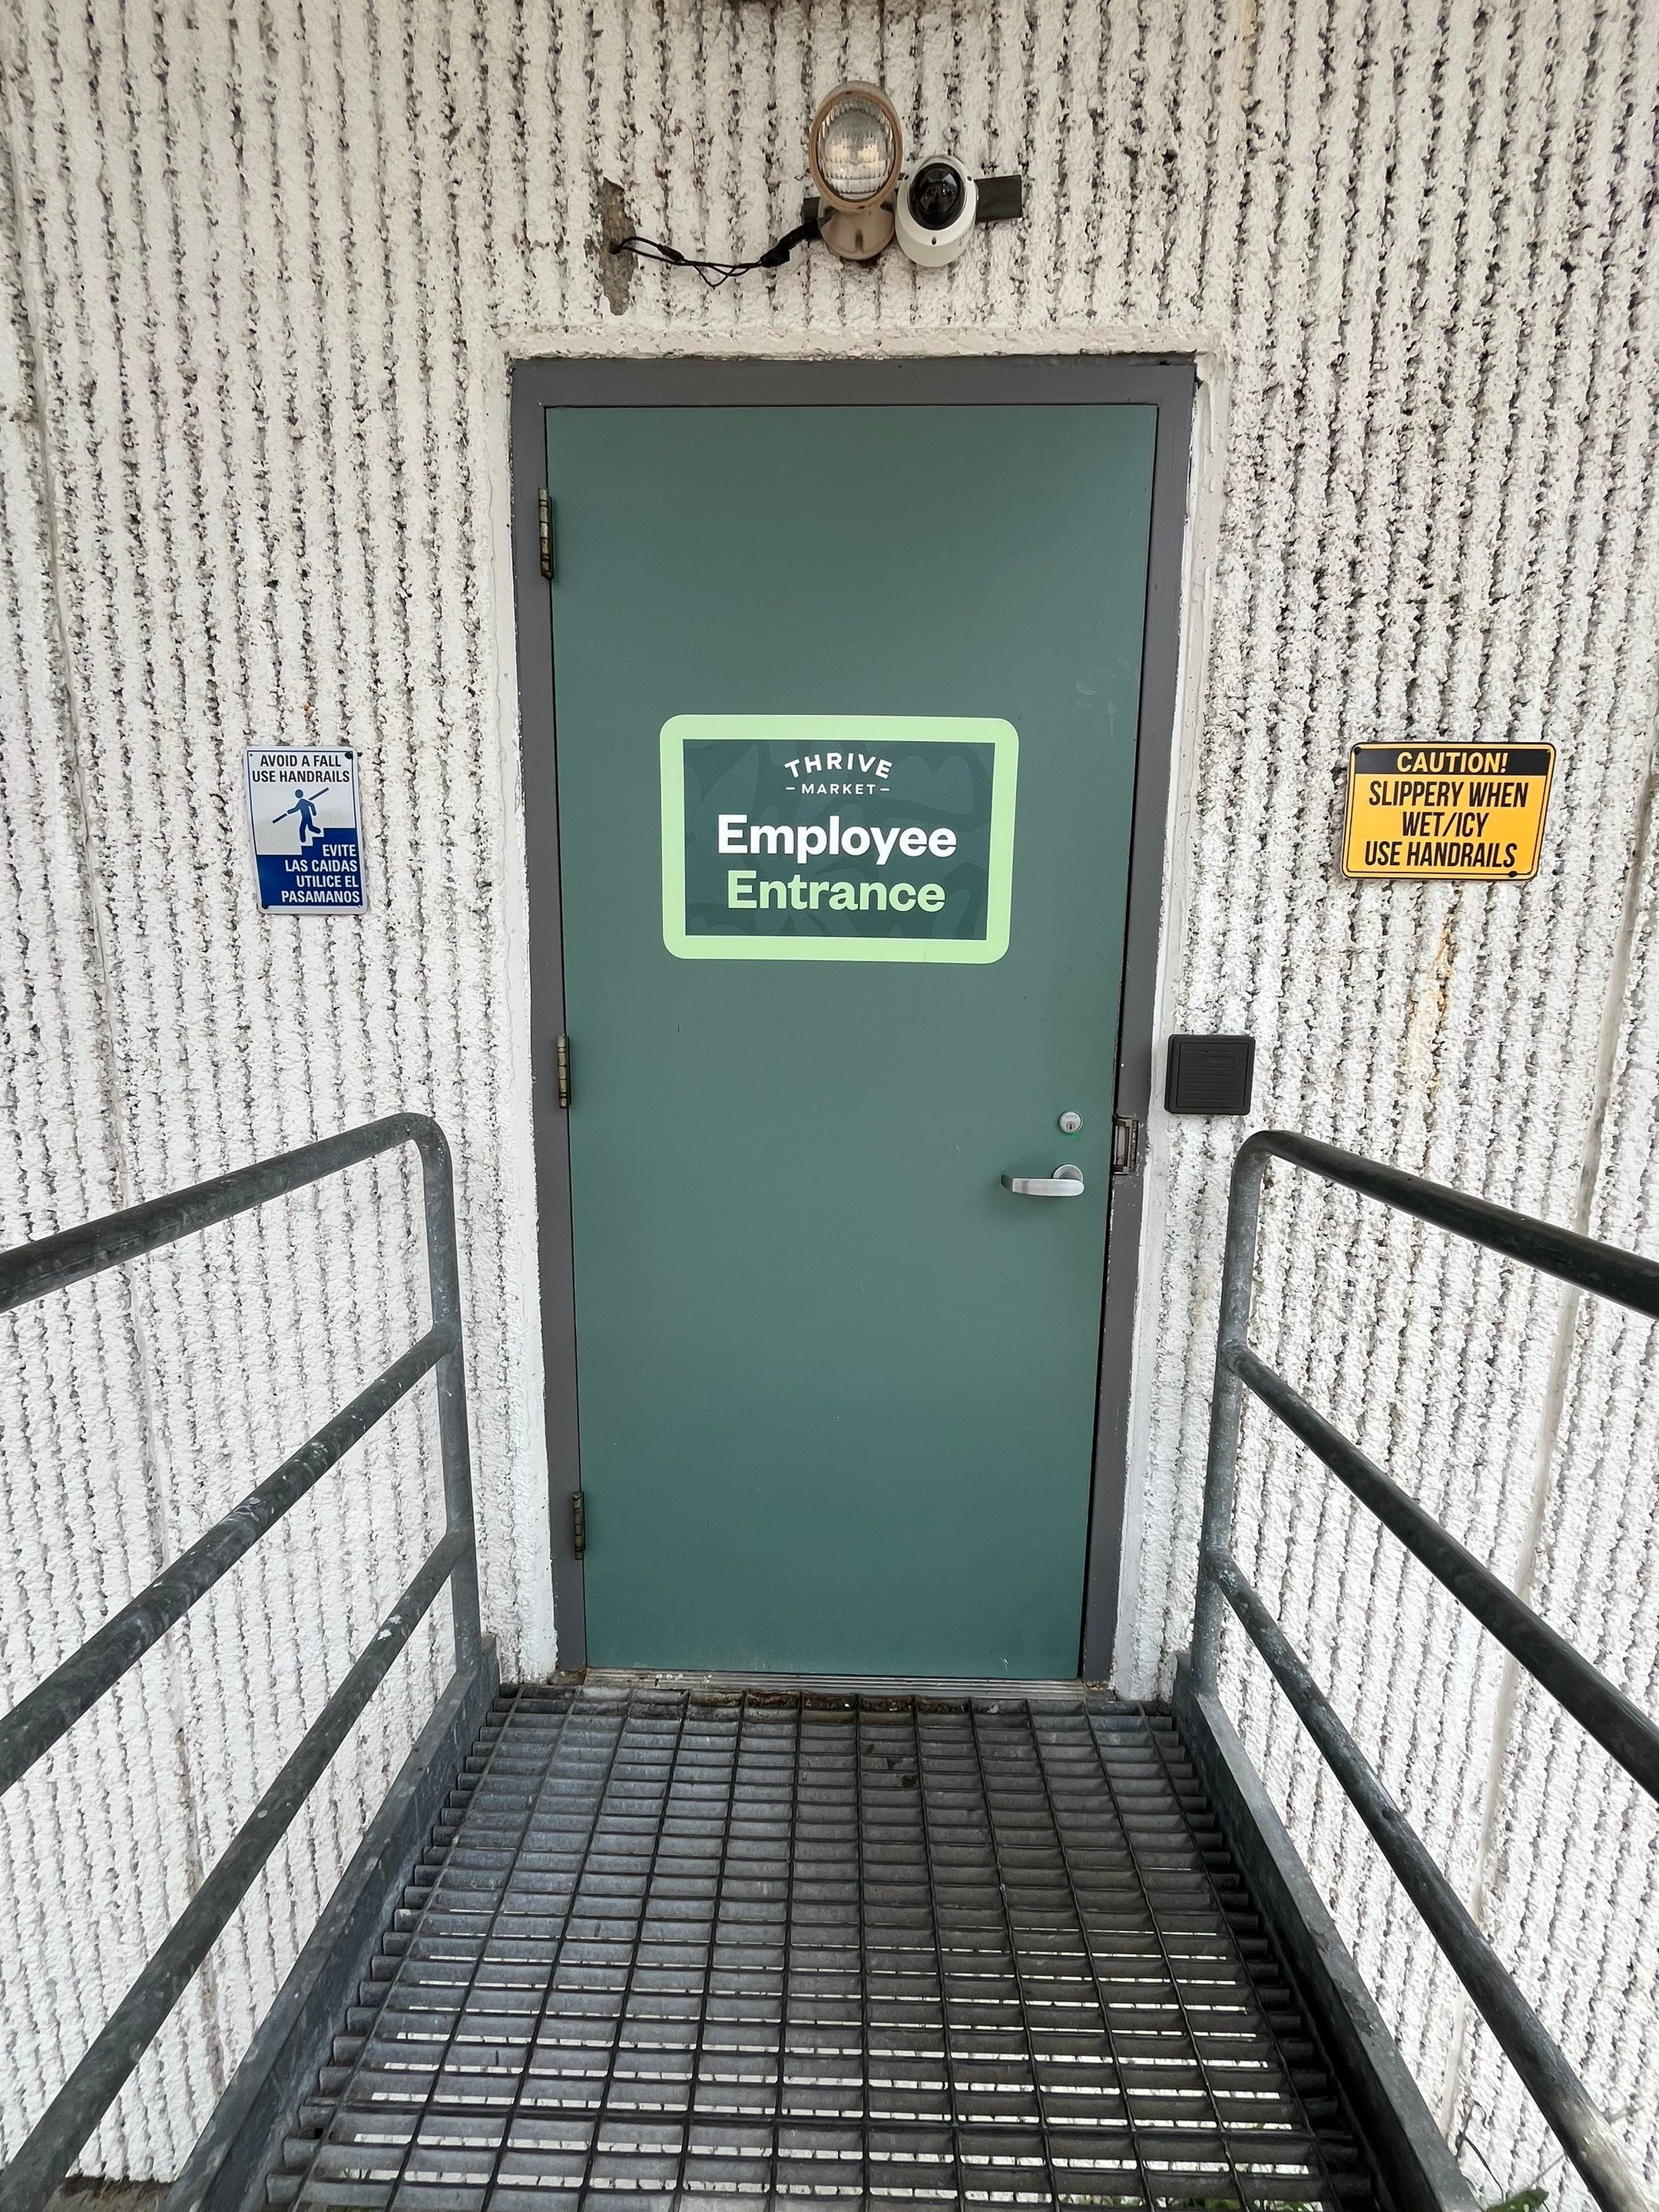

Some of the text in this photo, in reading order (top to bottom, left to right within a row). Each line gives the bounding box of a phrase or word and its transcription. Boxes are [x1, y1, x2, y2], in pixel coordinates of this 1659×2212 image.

[260, 754, 342, 767] AVOID A FALL
[783, 751, 894, 780] THRIVE
[1396, 751, 1509, 773] CAUTION!
[252, 770, 350, 783] USE HANDRAILS
[801, 783, 876, 796] MARKET
[1369, 780, 1529, 807] SLIPPERY WHEN
[1402, 811, 1490, 838] WET/ICY
[717, 813, 958, 866] Employee
[323, 844, 357, 857] EVITE
[1365, 840, 1518, 868] USE HANDRAILS
[285, 859, 358, 873] LAS CAIDAS
[296, 875, 359, 888] UTILICE EL
[727, 869, 946, 912] Entrance
[281, 890, 360, 903] PASAMANOS
